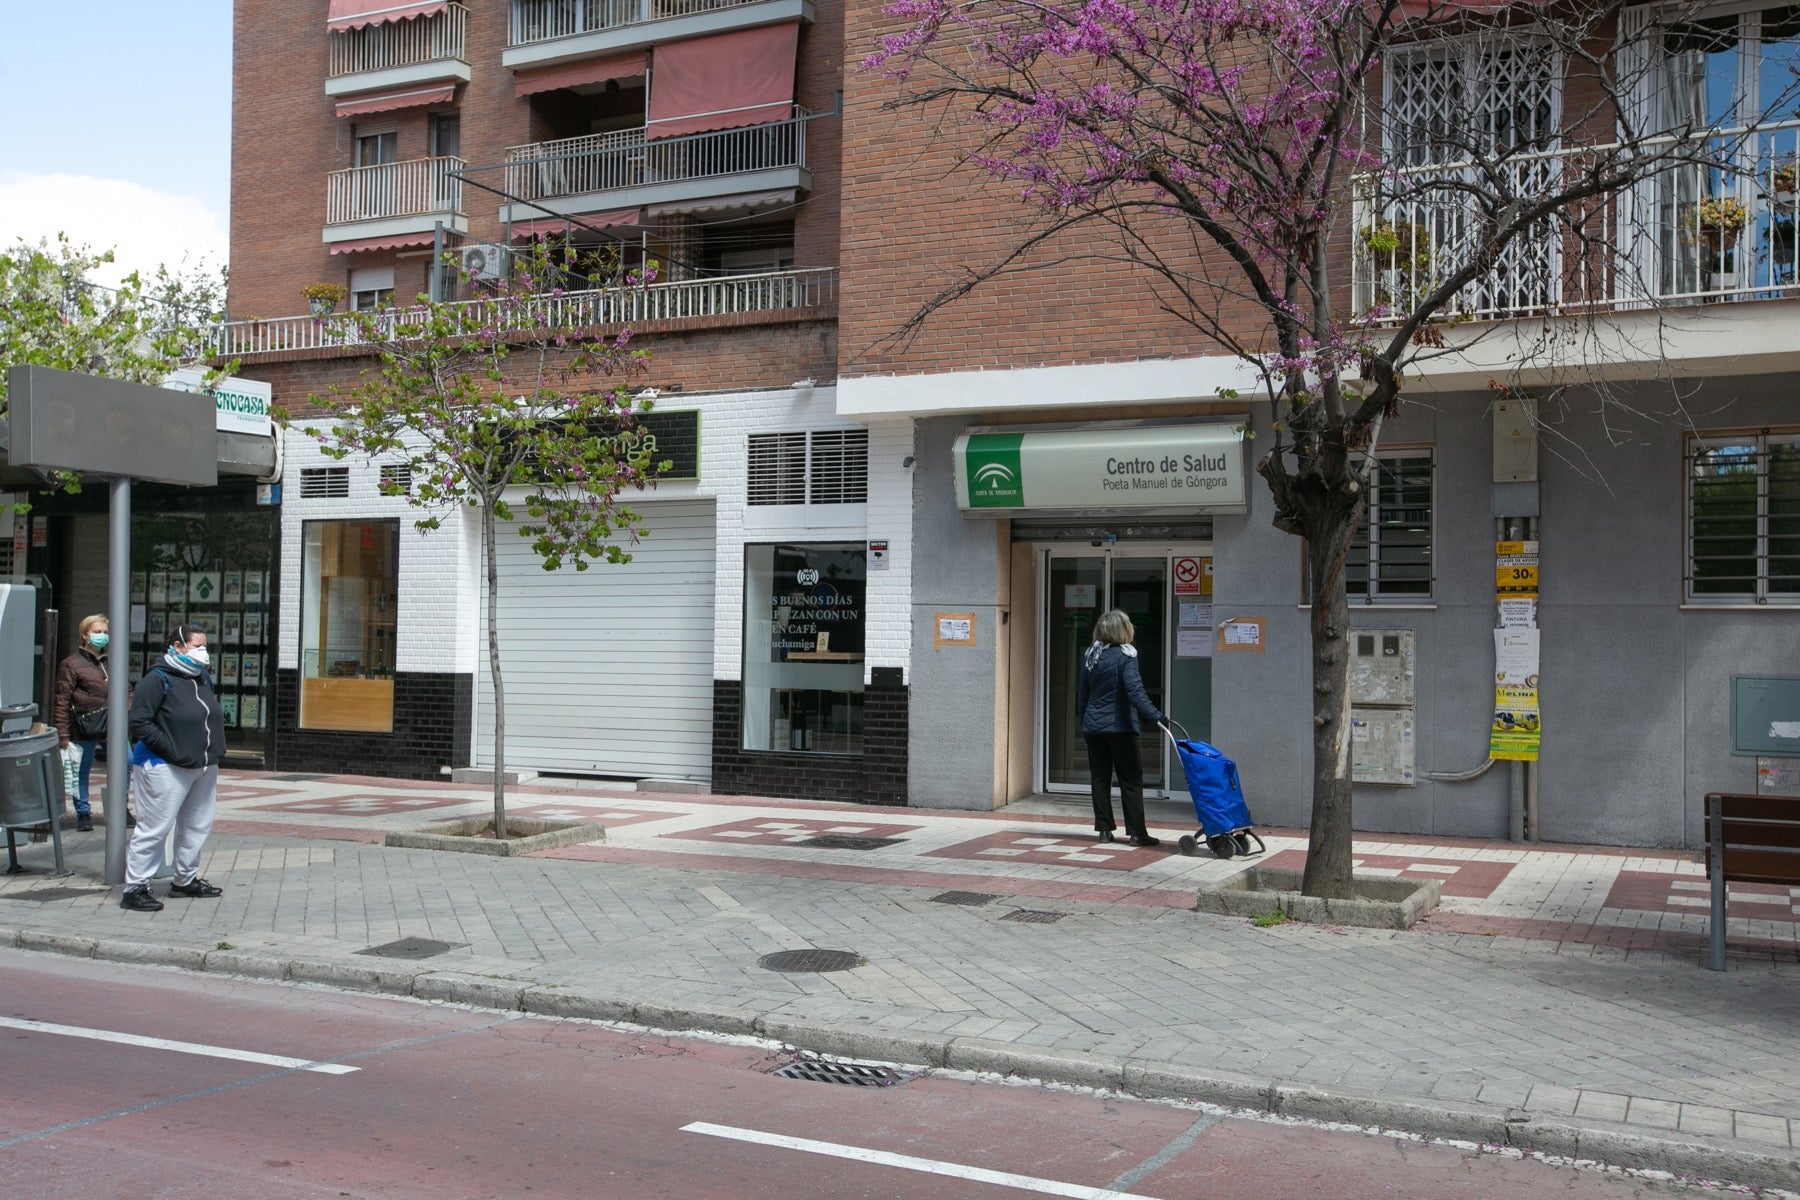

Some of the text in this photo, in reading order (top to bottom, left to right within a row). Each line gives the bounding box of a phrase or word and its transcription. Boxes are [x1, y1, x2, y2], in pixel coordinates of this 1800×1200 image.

[201, 389, 264, 415] CNOCASA
[1106, 453, 1226, 475] Centro de Salud
[1103, 475, 1228, 490] Poeta Manuel de Góngora
[780, 595, 825, 605] BUENOS
[826, 592, 853, 605] DÍAS
[816, 610, 839, 620] CON
[842, 610, 858, 620] UN
[788, 622, 817, 634] CAFÉ
[772, 639, 815, 651] uchamiga
